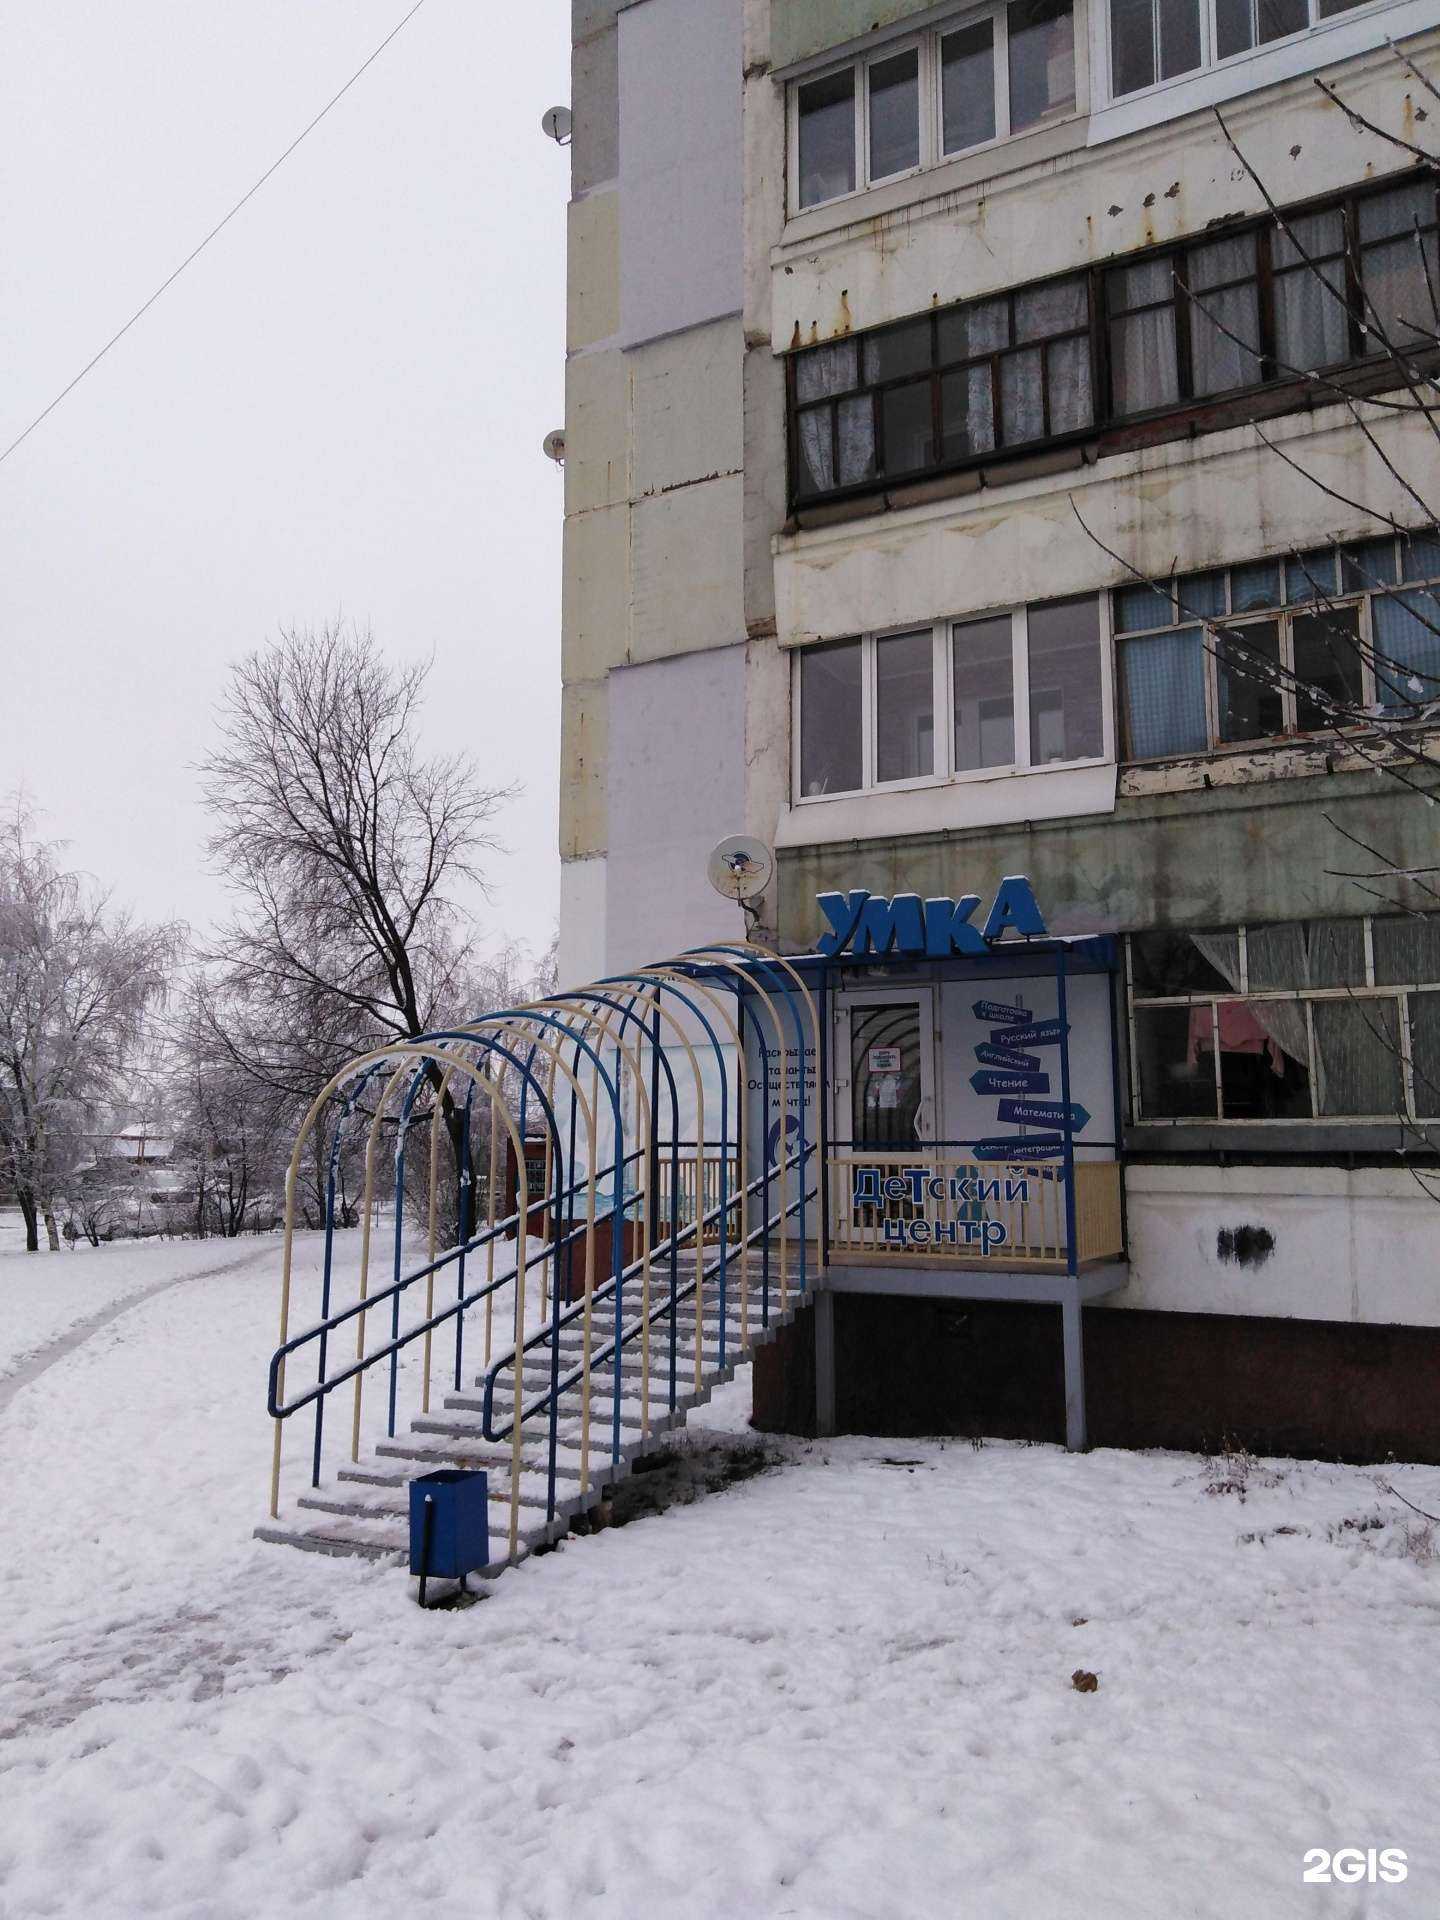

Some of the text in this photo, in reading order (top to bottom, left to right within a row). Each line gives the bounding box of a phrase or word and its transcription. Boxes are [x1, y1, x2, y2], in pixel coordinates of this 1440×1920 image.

[816, 875, 1047, 956] УМКА
[1000, 1030, 1037, 1045] Русский
[988, 1076, 1029, 1088] Чтение
[1013, 1105, 1076, 1121] Математиа
[883, 1218, 1007, 1257] центр
